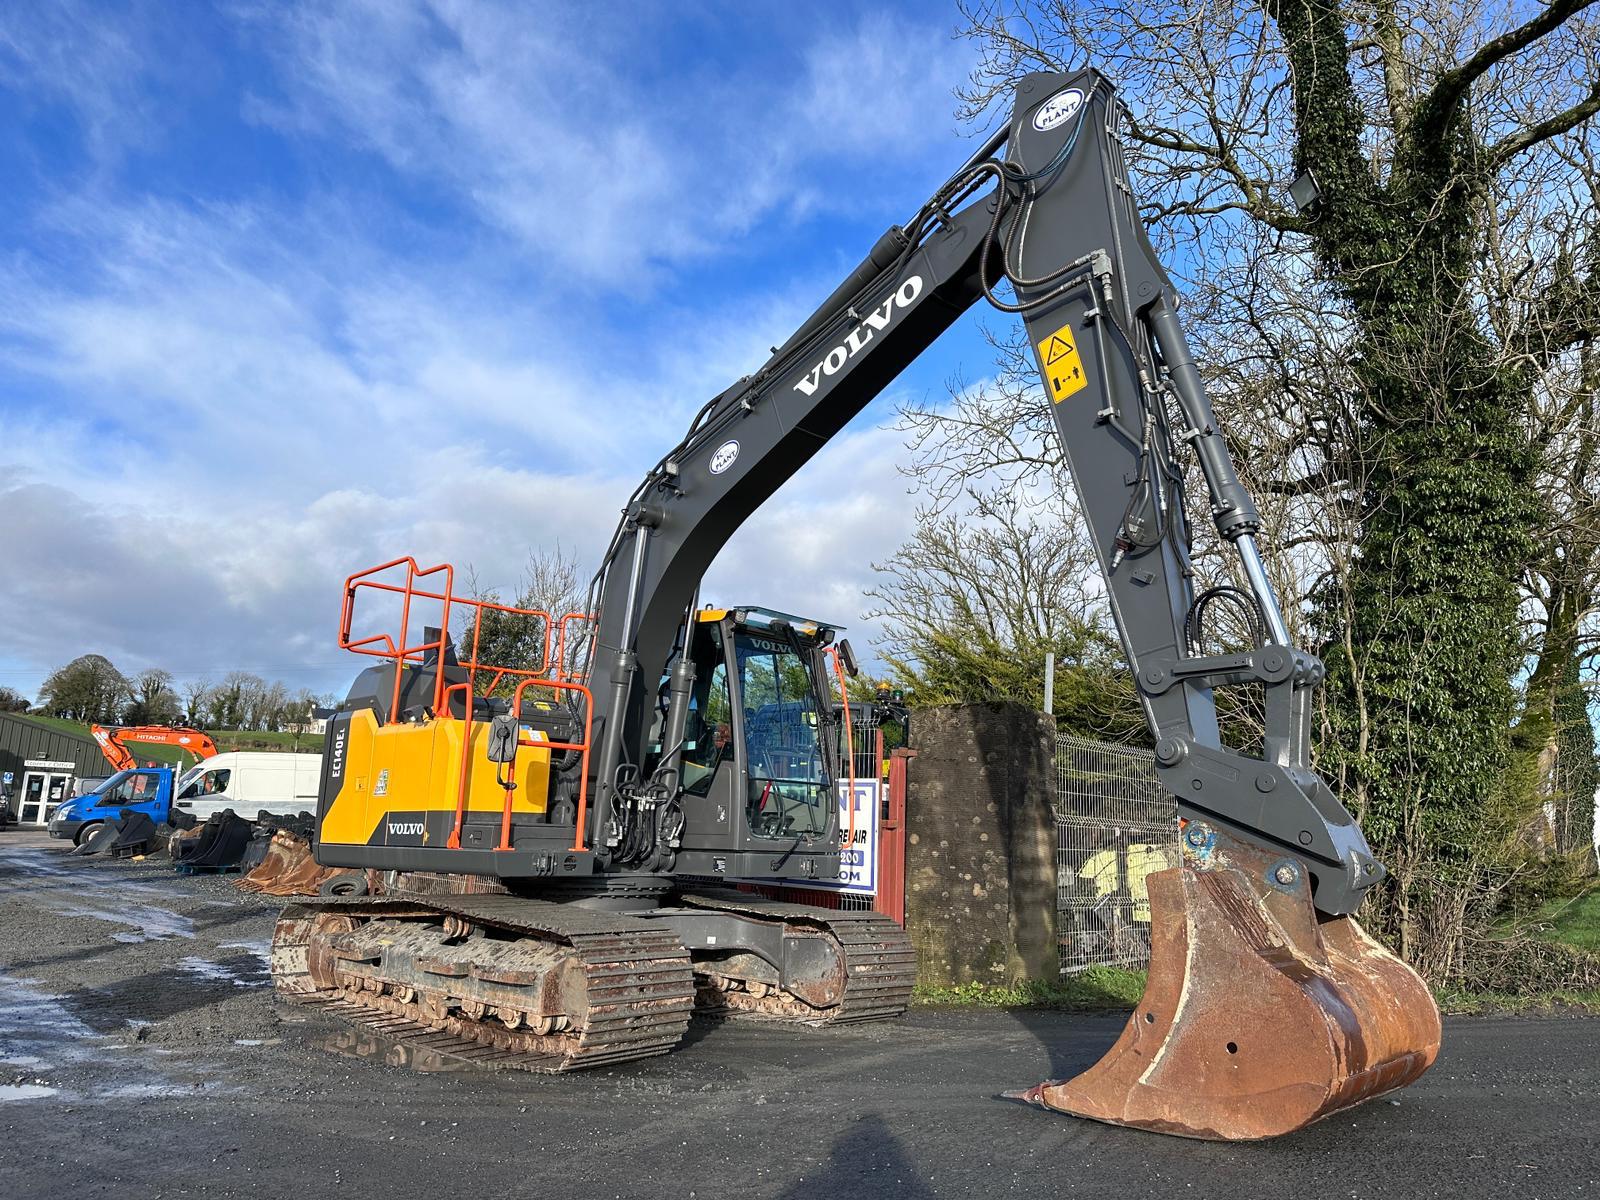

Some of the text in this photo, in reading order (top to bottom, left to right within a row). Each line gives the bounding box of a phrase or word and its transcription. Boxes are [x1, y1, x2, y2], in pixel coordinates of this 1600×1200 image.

[1042, 101, 1076, 126] PLANT
[793, 275, 923, 396] VOLVO
[715, 450, 735, 470] PLANT
[839, 789, 867, 811] NT
[388, 823, 424, 835] VOLVO
[832, 871, 860, 881] OM
